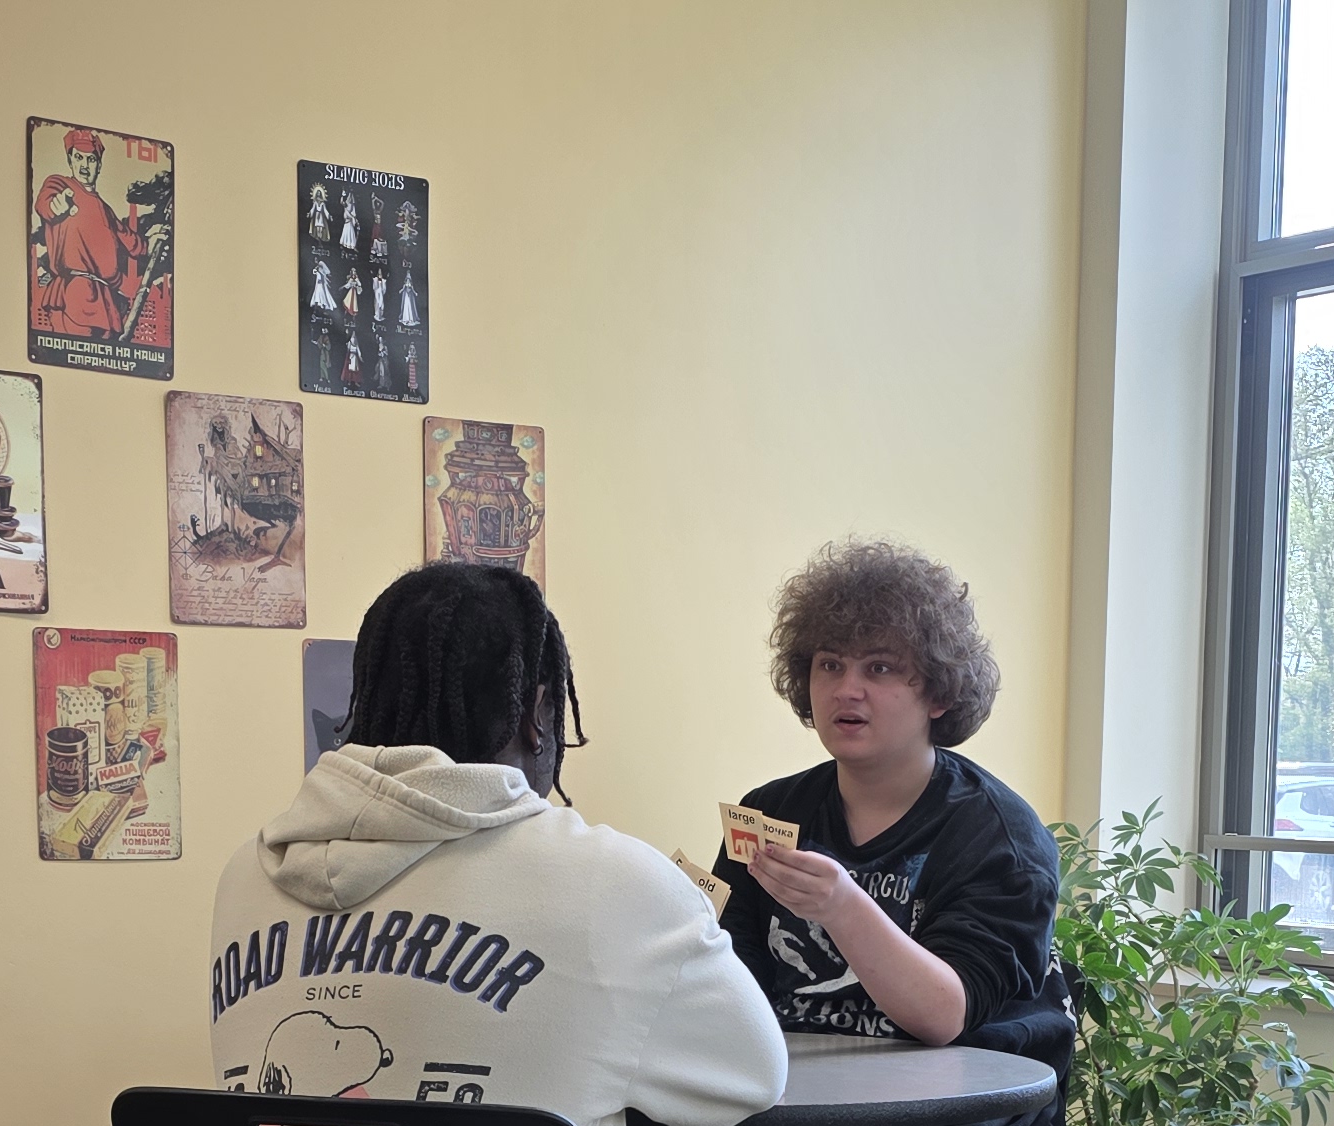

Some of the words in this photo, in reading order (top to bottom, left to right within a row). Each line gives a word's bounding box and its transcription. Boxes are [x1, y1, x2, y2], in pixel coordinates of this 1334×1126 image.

[37, 335, 113, 356] ПОДПИСАЛСЯ
[116, 346, 131, 358] НА
[134, 348, 165, 363] НАШУ
[67, 353, 137, 371] СТРАНИЦУ?
[99, 763, 137, 782] КАША
[728, 809, 755, 825] large
[698, 878, 716, 893] old
[212, 920, 289, 1025] ROAD
[299, 910, 545, 1013] WARRIOR
[305, 984, 363, 1001] SINCE
